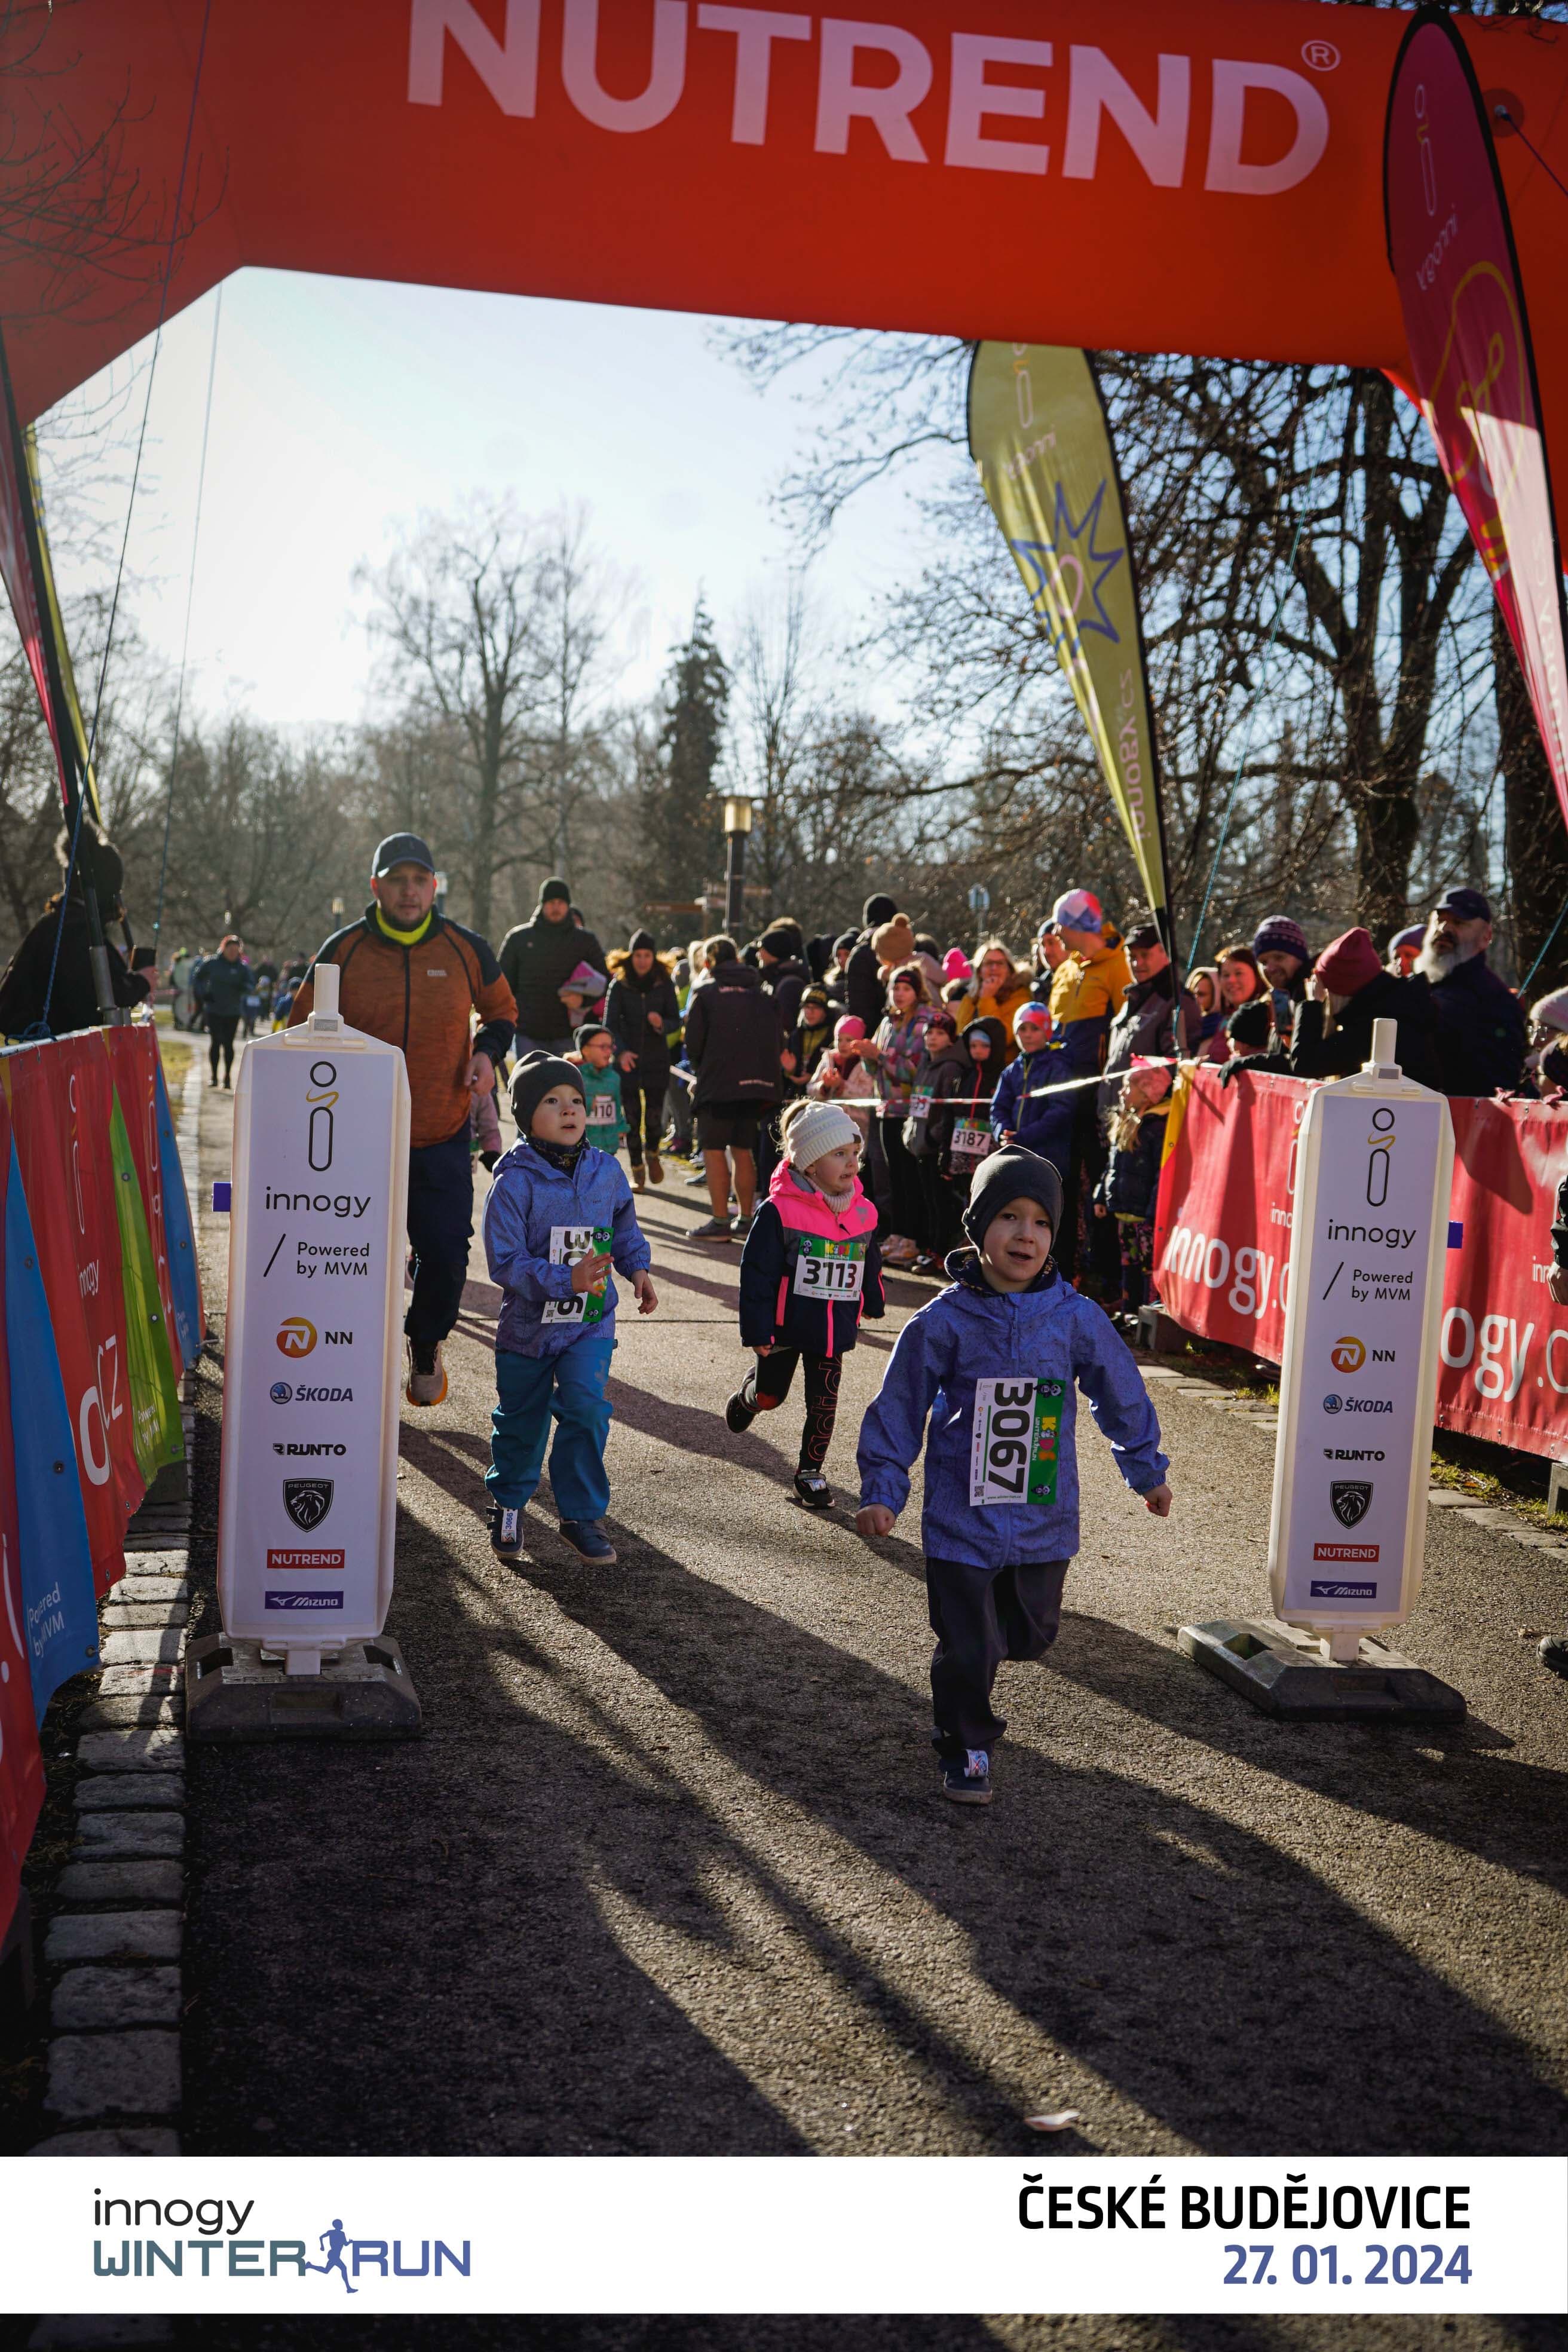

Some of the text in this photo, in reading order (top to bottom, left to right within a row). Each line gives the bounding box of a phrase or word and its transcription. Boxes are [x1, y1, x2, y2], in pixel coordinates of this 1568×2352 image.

[408, 0, 1329, 195] NUTREND
[954, 1130, 985, 1146] 3187
[265, 1186, 372, 1218] innogy
[1327, 1218, 1417, 1249] innogy
[298, 1241, 370, 1257] Powered
[296, 1260, 368, 1278] by MVM
[557, 1230, 591, 1316] 306
[803, 1258, 858, 1289] 3113
[1352, 1269, 1413, 1284] Powered
[1351, 1287, 1411, 1302] by MVM
[324, 1331, 353, 1345] NN
[1371, 1349, 1396, 1362] NN
[295, 1385, 354, 1402] ŠKODA
[1344, 1396, 1394, 1414] ŠKODA
[988, 1382, 1034, 1494] 3067
[286, 1443, 347, 1456] RUNTO
[1334, 1449, 1385, 1462] RUNTO
[505, 1512, 513, 1530] 3066
[271, 1553, 342, 1565] NUTREND
[1318, 1546, 1376, 1559] NUTREND
